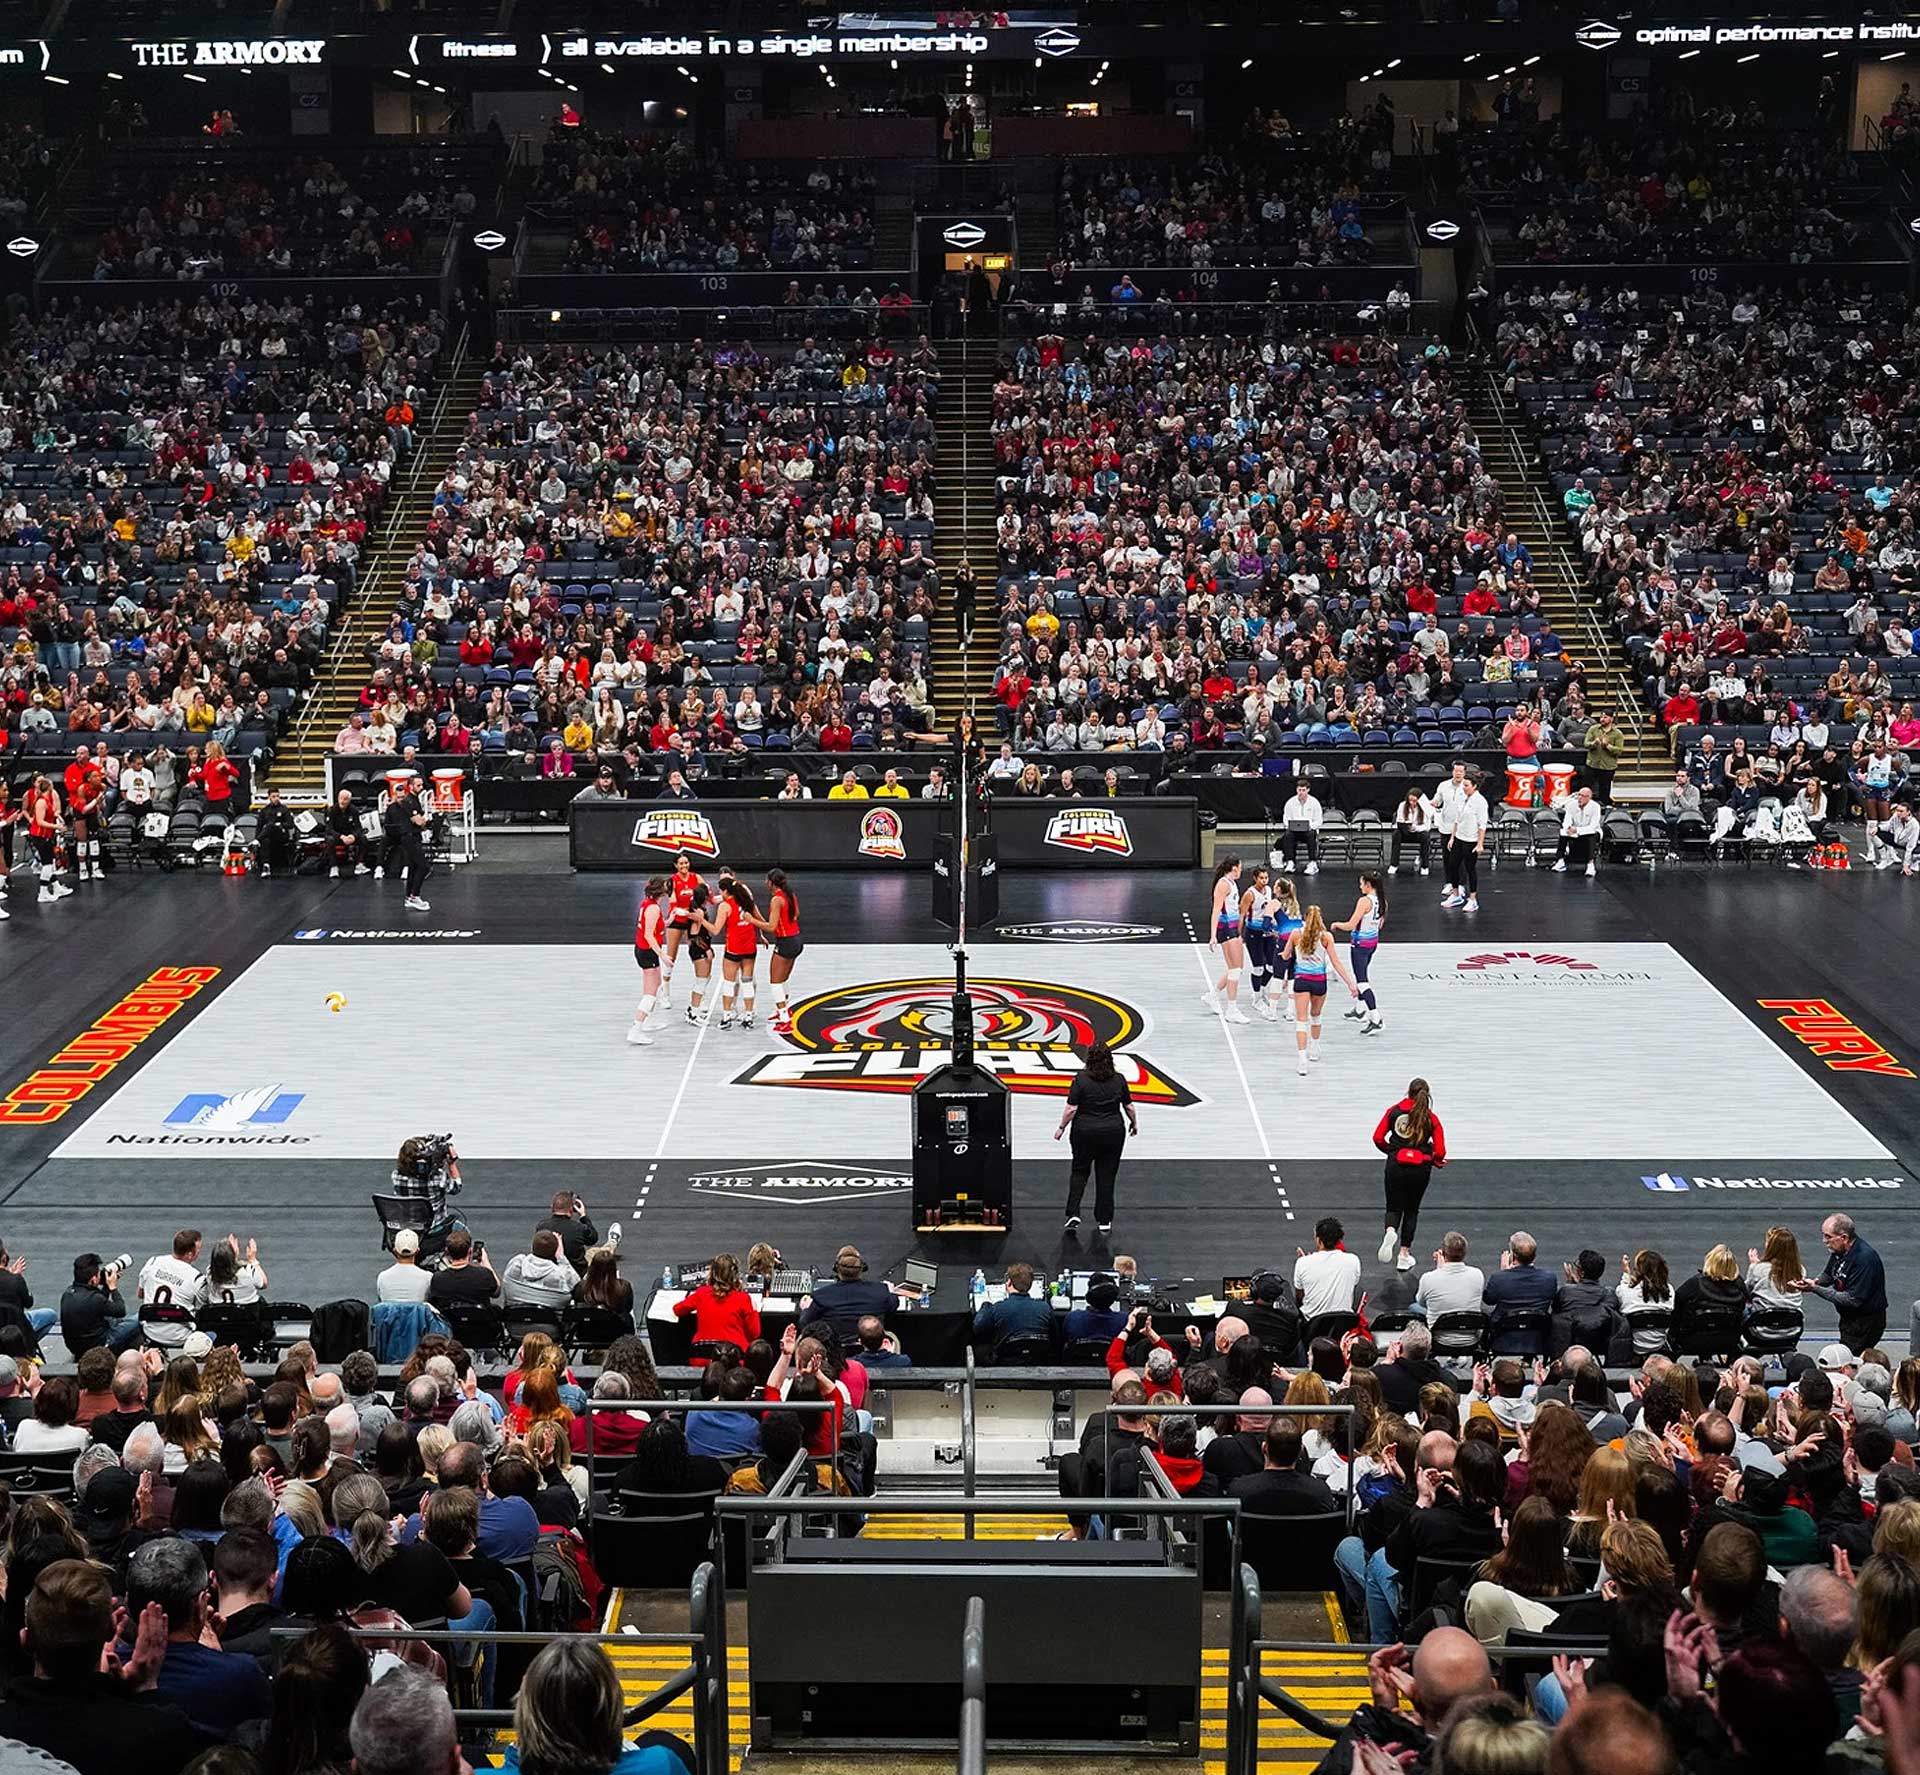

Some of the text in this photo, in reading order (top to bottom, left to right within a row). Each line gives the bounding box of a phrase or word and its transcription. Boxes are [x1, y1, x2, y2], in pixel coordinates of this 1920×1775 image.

[1636, 26, 1710, 45] optimal
[1716, 25, 1853, 44] performance
[443, 42, 516, 57] fitness
[563, 33, 987, 56] all available in a single membership
[132, 41, 325, 65] THE ARMORY
[1191, 271, 1219, 286] 104
[1689, 267, 1718, 281] 105
[210, 282, 239, 297] 102
[699, 276, 728, 291] 103
[440, 782, 453, 795] G
[1518, 778, 1530, 791] G
[1553, 779, 1566, 790] G
[1063, 811, 1111, 820] COLUMBUS
[637, 819, 708, 841] FURY
[1050, 817, 1121, 840] FURY
[862, 838, 900, 850] FURY
[330, 930, 475, 938] Nationwide
[995, 926, 1165, 935] THE ARMORY
[0, 966, 221, 1125] COLUMBUS
[1756, 999, 1917, 1079] FURY
[832, 1042, 1072, 1051] COLUBUS
[106, 1134, 310, 1144] Nationwide
[688, 1176, 913, 1188] THE ARMORY
[1692, 1177, 1901, 1189] Nationwide
